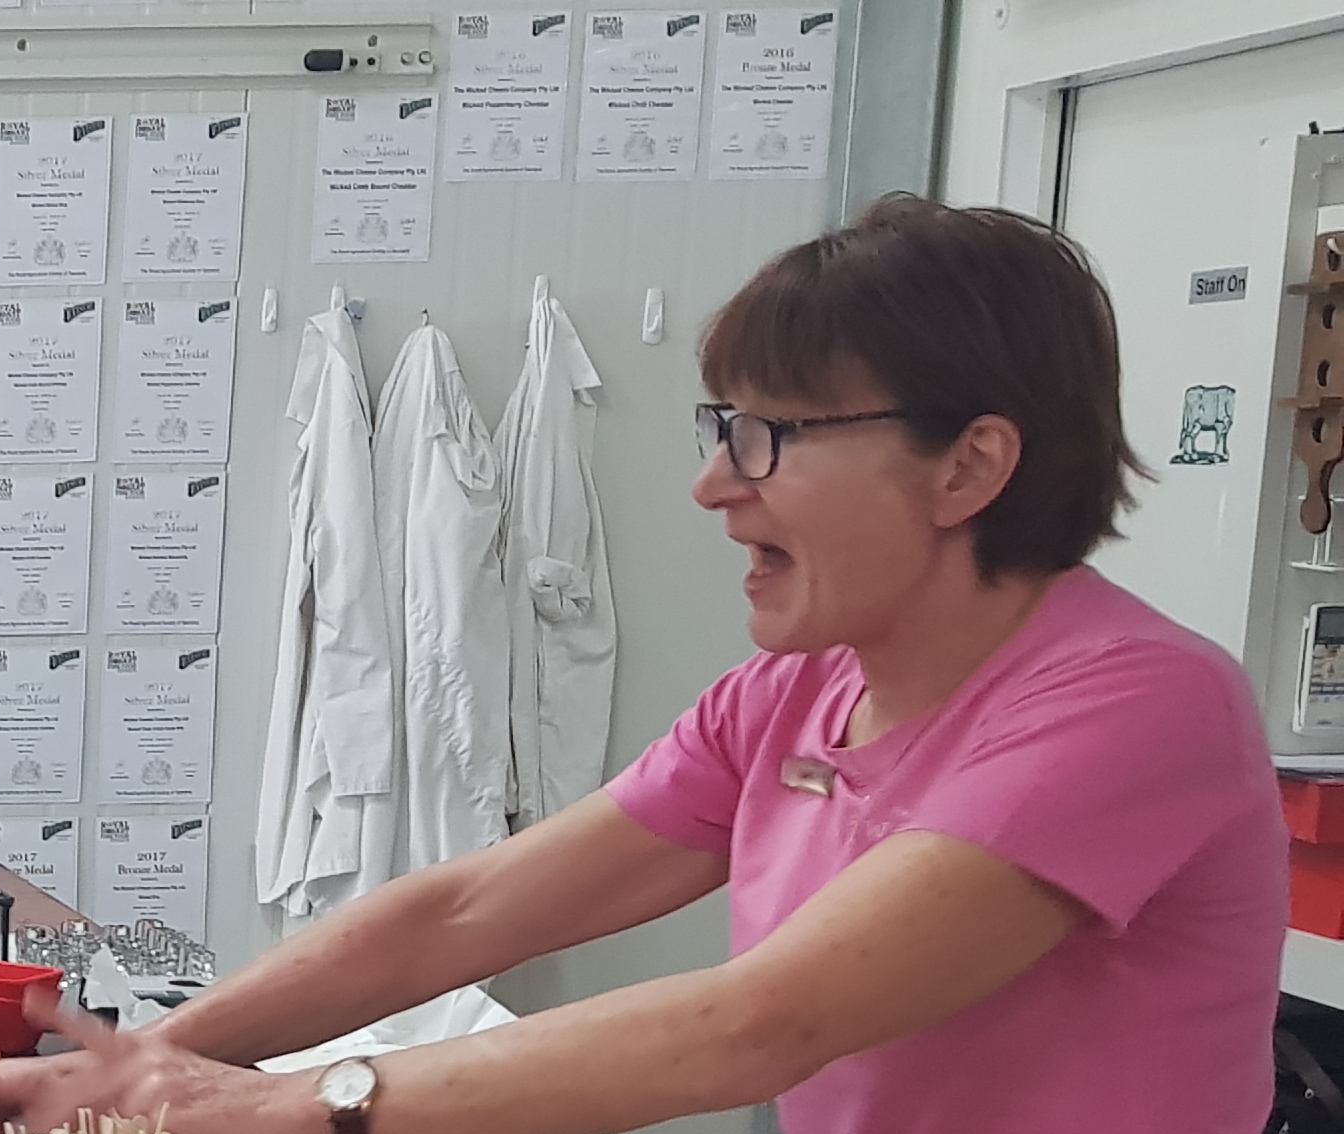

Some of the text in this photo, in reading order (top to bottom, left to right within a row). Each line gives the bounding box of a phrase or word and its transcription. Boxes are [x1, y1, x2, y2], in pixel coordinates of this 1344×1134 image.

[763, 48, 794, 58] 2016
[780, 61, 811, 72] Medal
[1196, 277, 1226, 295] Staff
[8, 852, 37, 862] 2017
[137, 851, 167, 862] 2017
[24, 864, 54, 875] Medal
[153, 863, 184, 874] Medal
